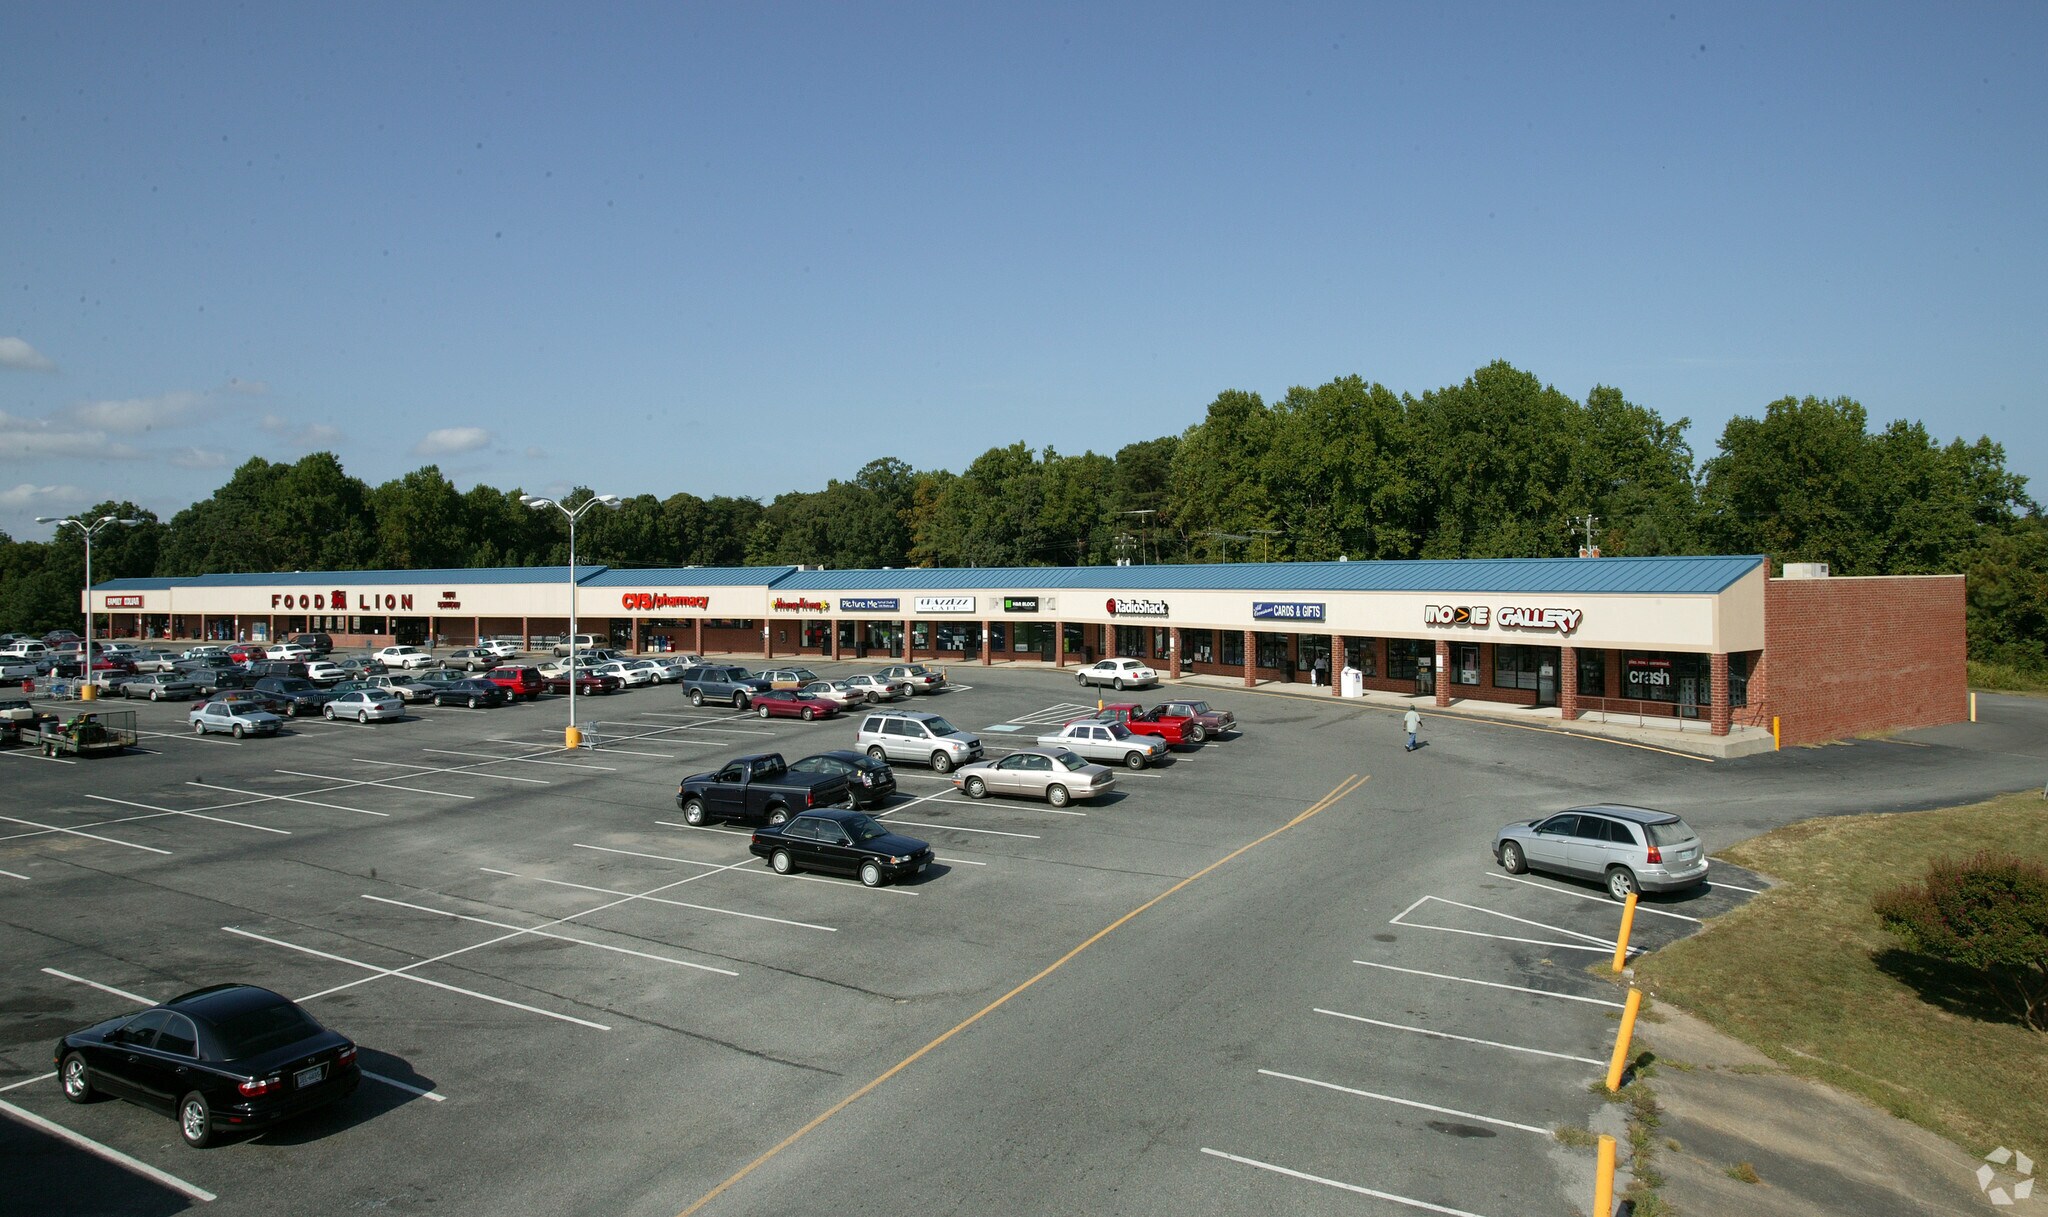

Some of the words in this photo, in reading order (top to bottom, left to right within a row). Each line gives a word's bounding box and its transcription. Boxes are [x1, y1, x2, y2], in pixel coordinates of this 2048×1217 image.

[271, 594, 325, 610] FOOD
[359, 594, 413, 611] LION
[841, 600, 865, 609] Picture
[867, 600, 878, 609] Me
[1115, 600, 1168, 614] RadioShack
[1273, 605, 1294, 617] CARDS
[1295, 605, 1301, 617] &
[1302, 605, 1320, 618] GIFTS
[1497, 607, 1581, 632] GALLERY
[1629, 668, 1670, 686] crash
